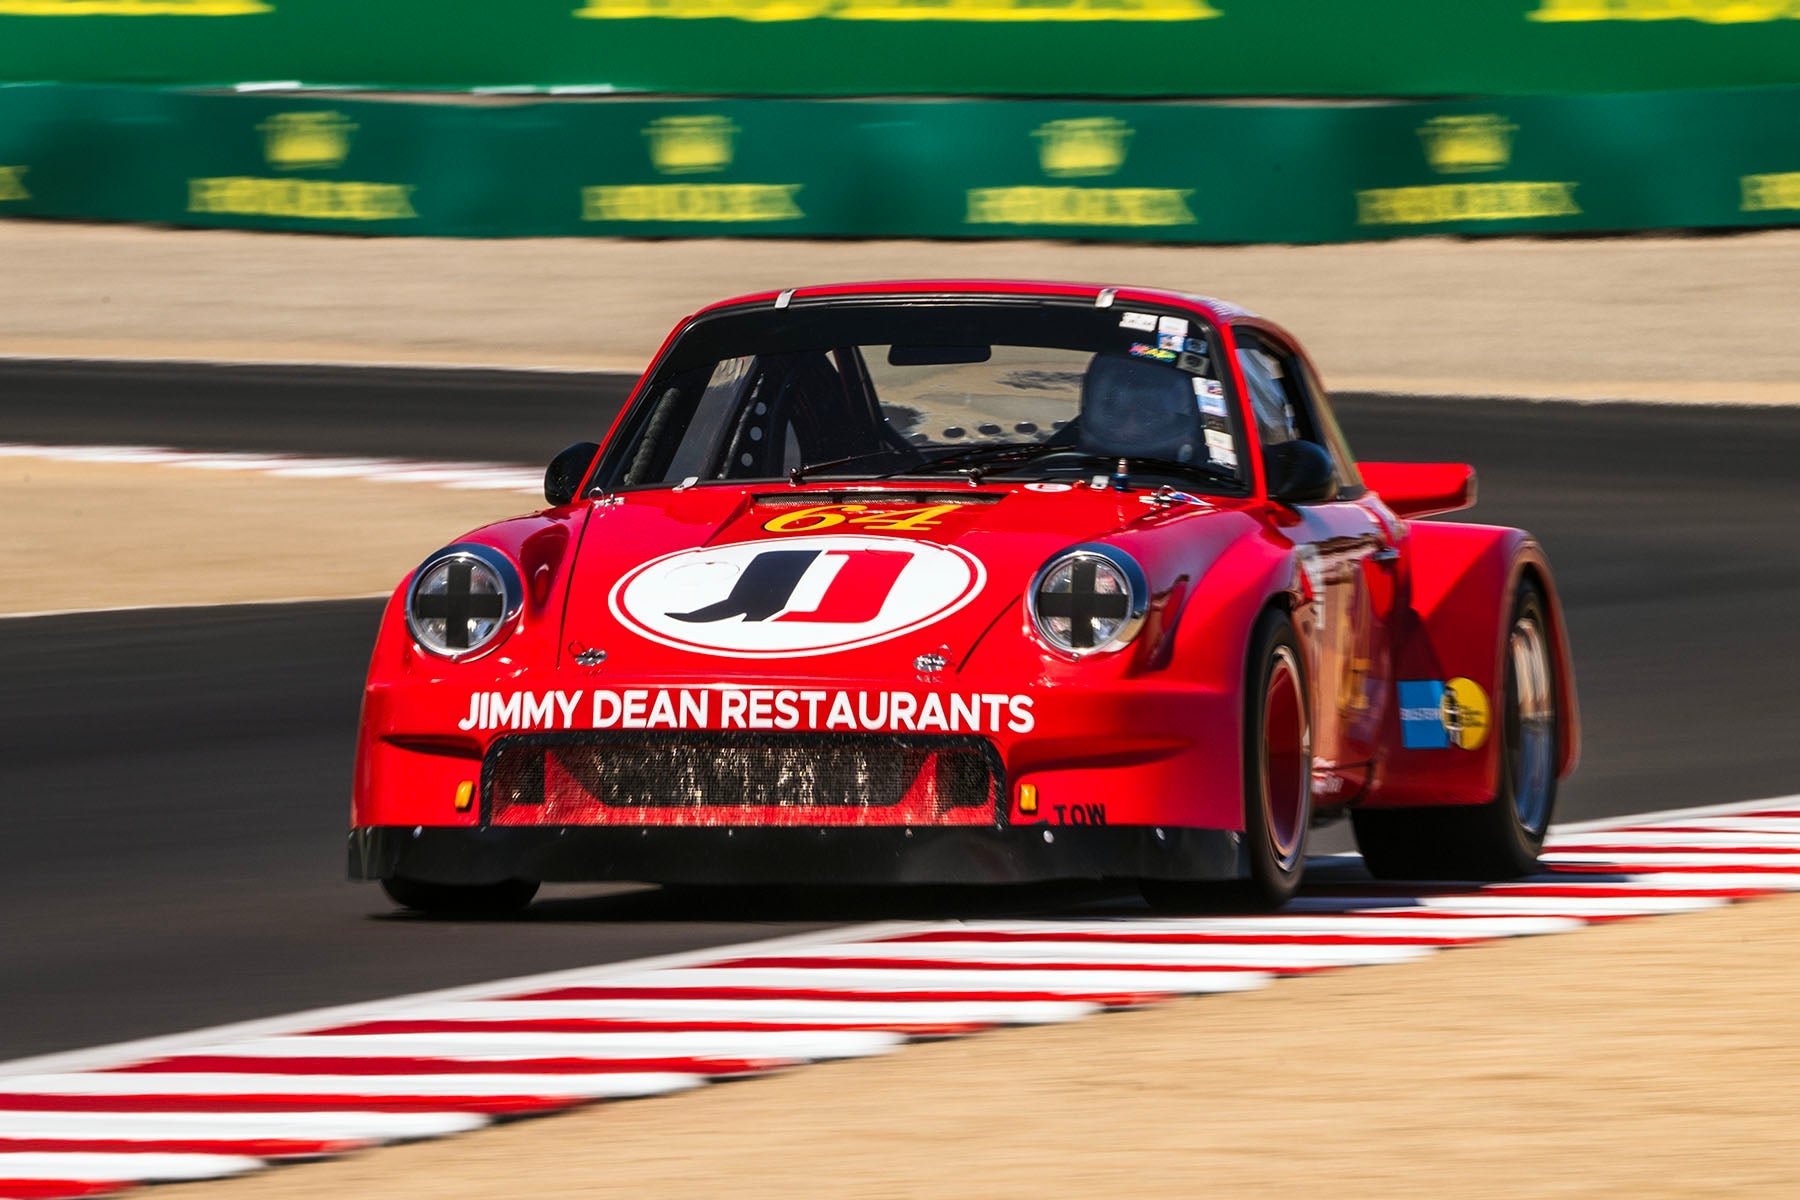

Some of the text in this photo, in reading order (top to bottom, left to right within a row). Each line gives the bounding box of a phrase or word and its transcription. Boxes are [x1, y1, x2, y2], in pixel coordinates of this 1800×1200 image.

[761, 504, 963, 532] 64
[458, 690, 1035, 734] JIMMY DEAN RESTAURANTS
[1053, 803, 1106, 826] TOW
